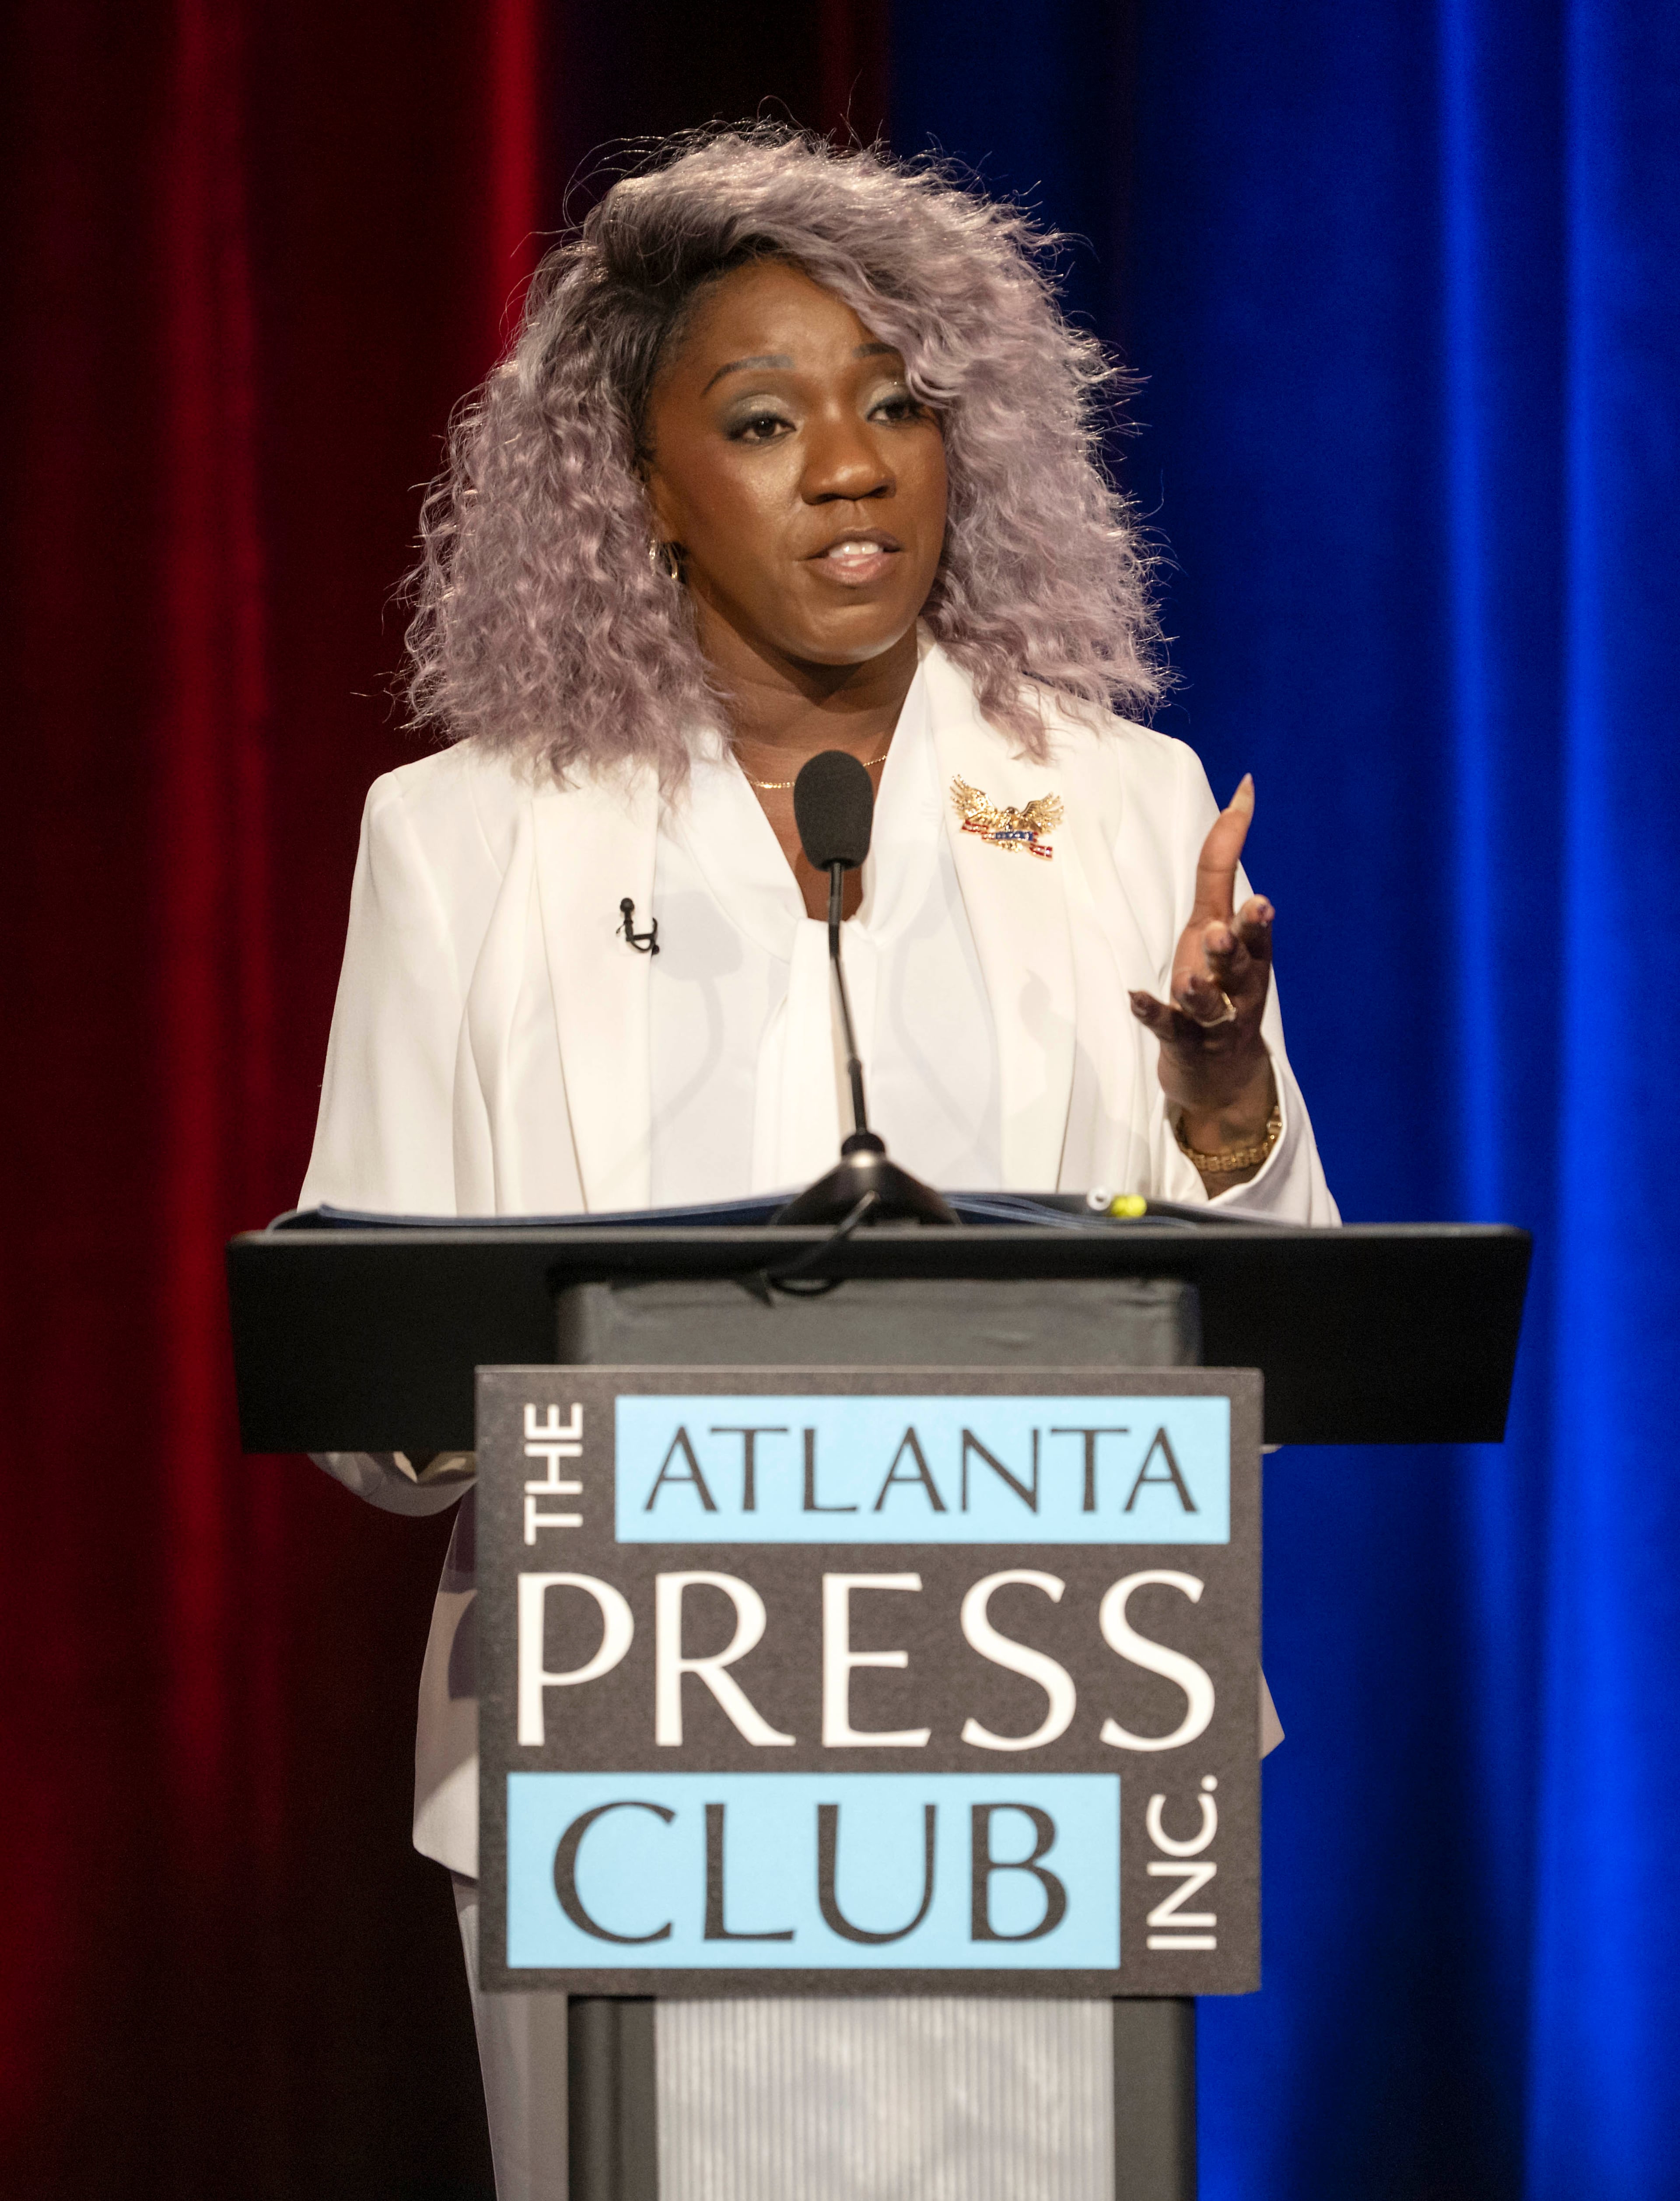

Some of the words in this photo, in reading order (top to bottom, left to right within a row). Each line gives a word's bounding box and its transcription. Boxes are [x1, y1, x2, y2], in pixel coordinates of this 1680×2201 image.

[525, 1403, 583, 1545] THE
[644, 1426, 1198, 1514] ATLANTA
[518, 1569, 1215, 1751] PRESS
[552, 1801, 1068, 1945] CLUB
[1146, 1775, 1218, 1949] INC.
